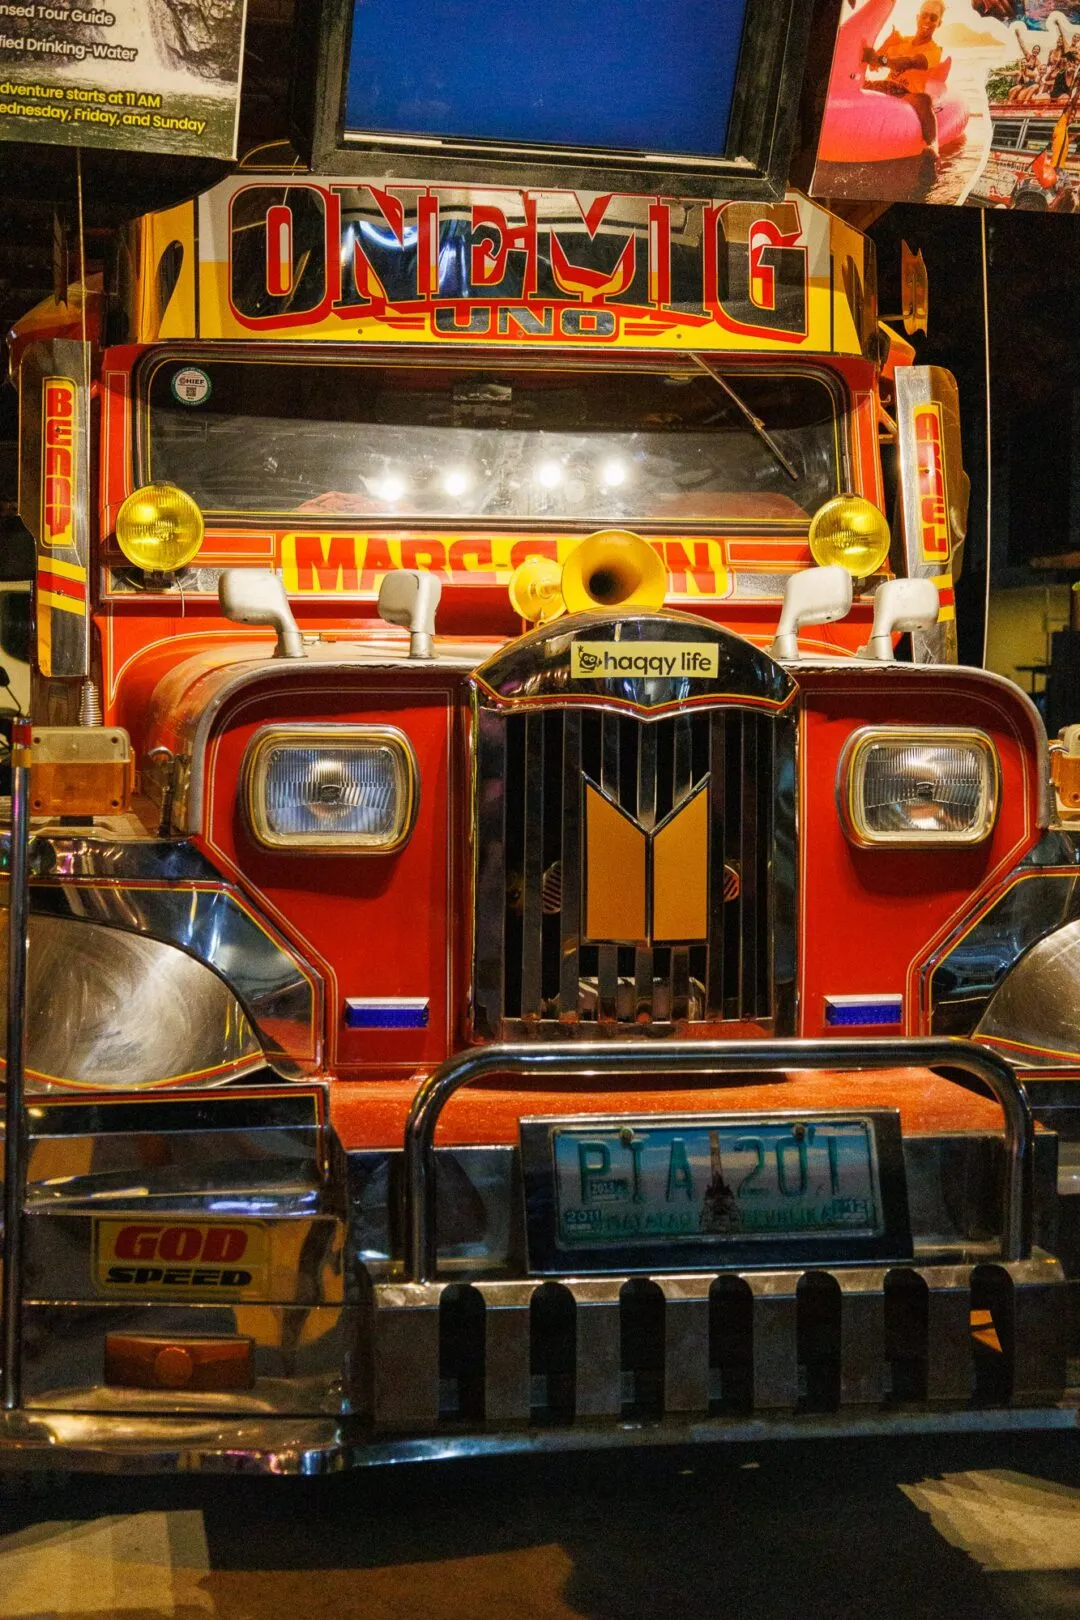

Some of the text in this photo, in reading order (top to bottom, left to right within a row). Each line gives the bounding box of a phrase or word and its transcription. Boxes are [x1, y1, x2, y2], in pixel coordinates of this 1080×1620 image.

[37, 6, 69, 20] Tour
[71, 9, 114, 25] Guide
[26, 38, 137, 60] Drinking-Water
[66, 88, 106, 103] starts
[108, 92, 123, 105] at
[125, 93, 136, 106] 11
[138, 94, 160, 108] AM
[73, 107, 120, 127] Friday,
[122, 113, 151, 127] and
[152, 115, 206, 136] Sunday
[433, 306, 617, 337] UNO
[681, 652, 712, 671] life
[114, 1226, 248, 1263] GOD
[105, 1267, 252, 1287] SPEED
